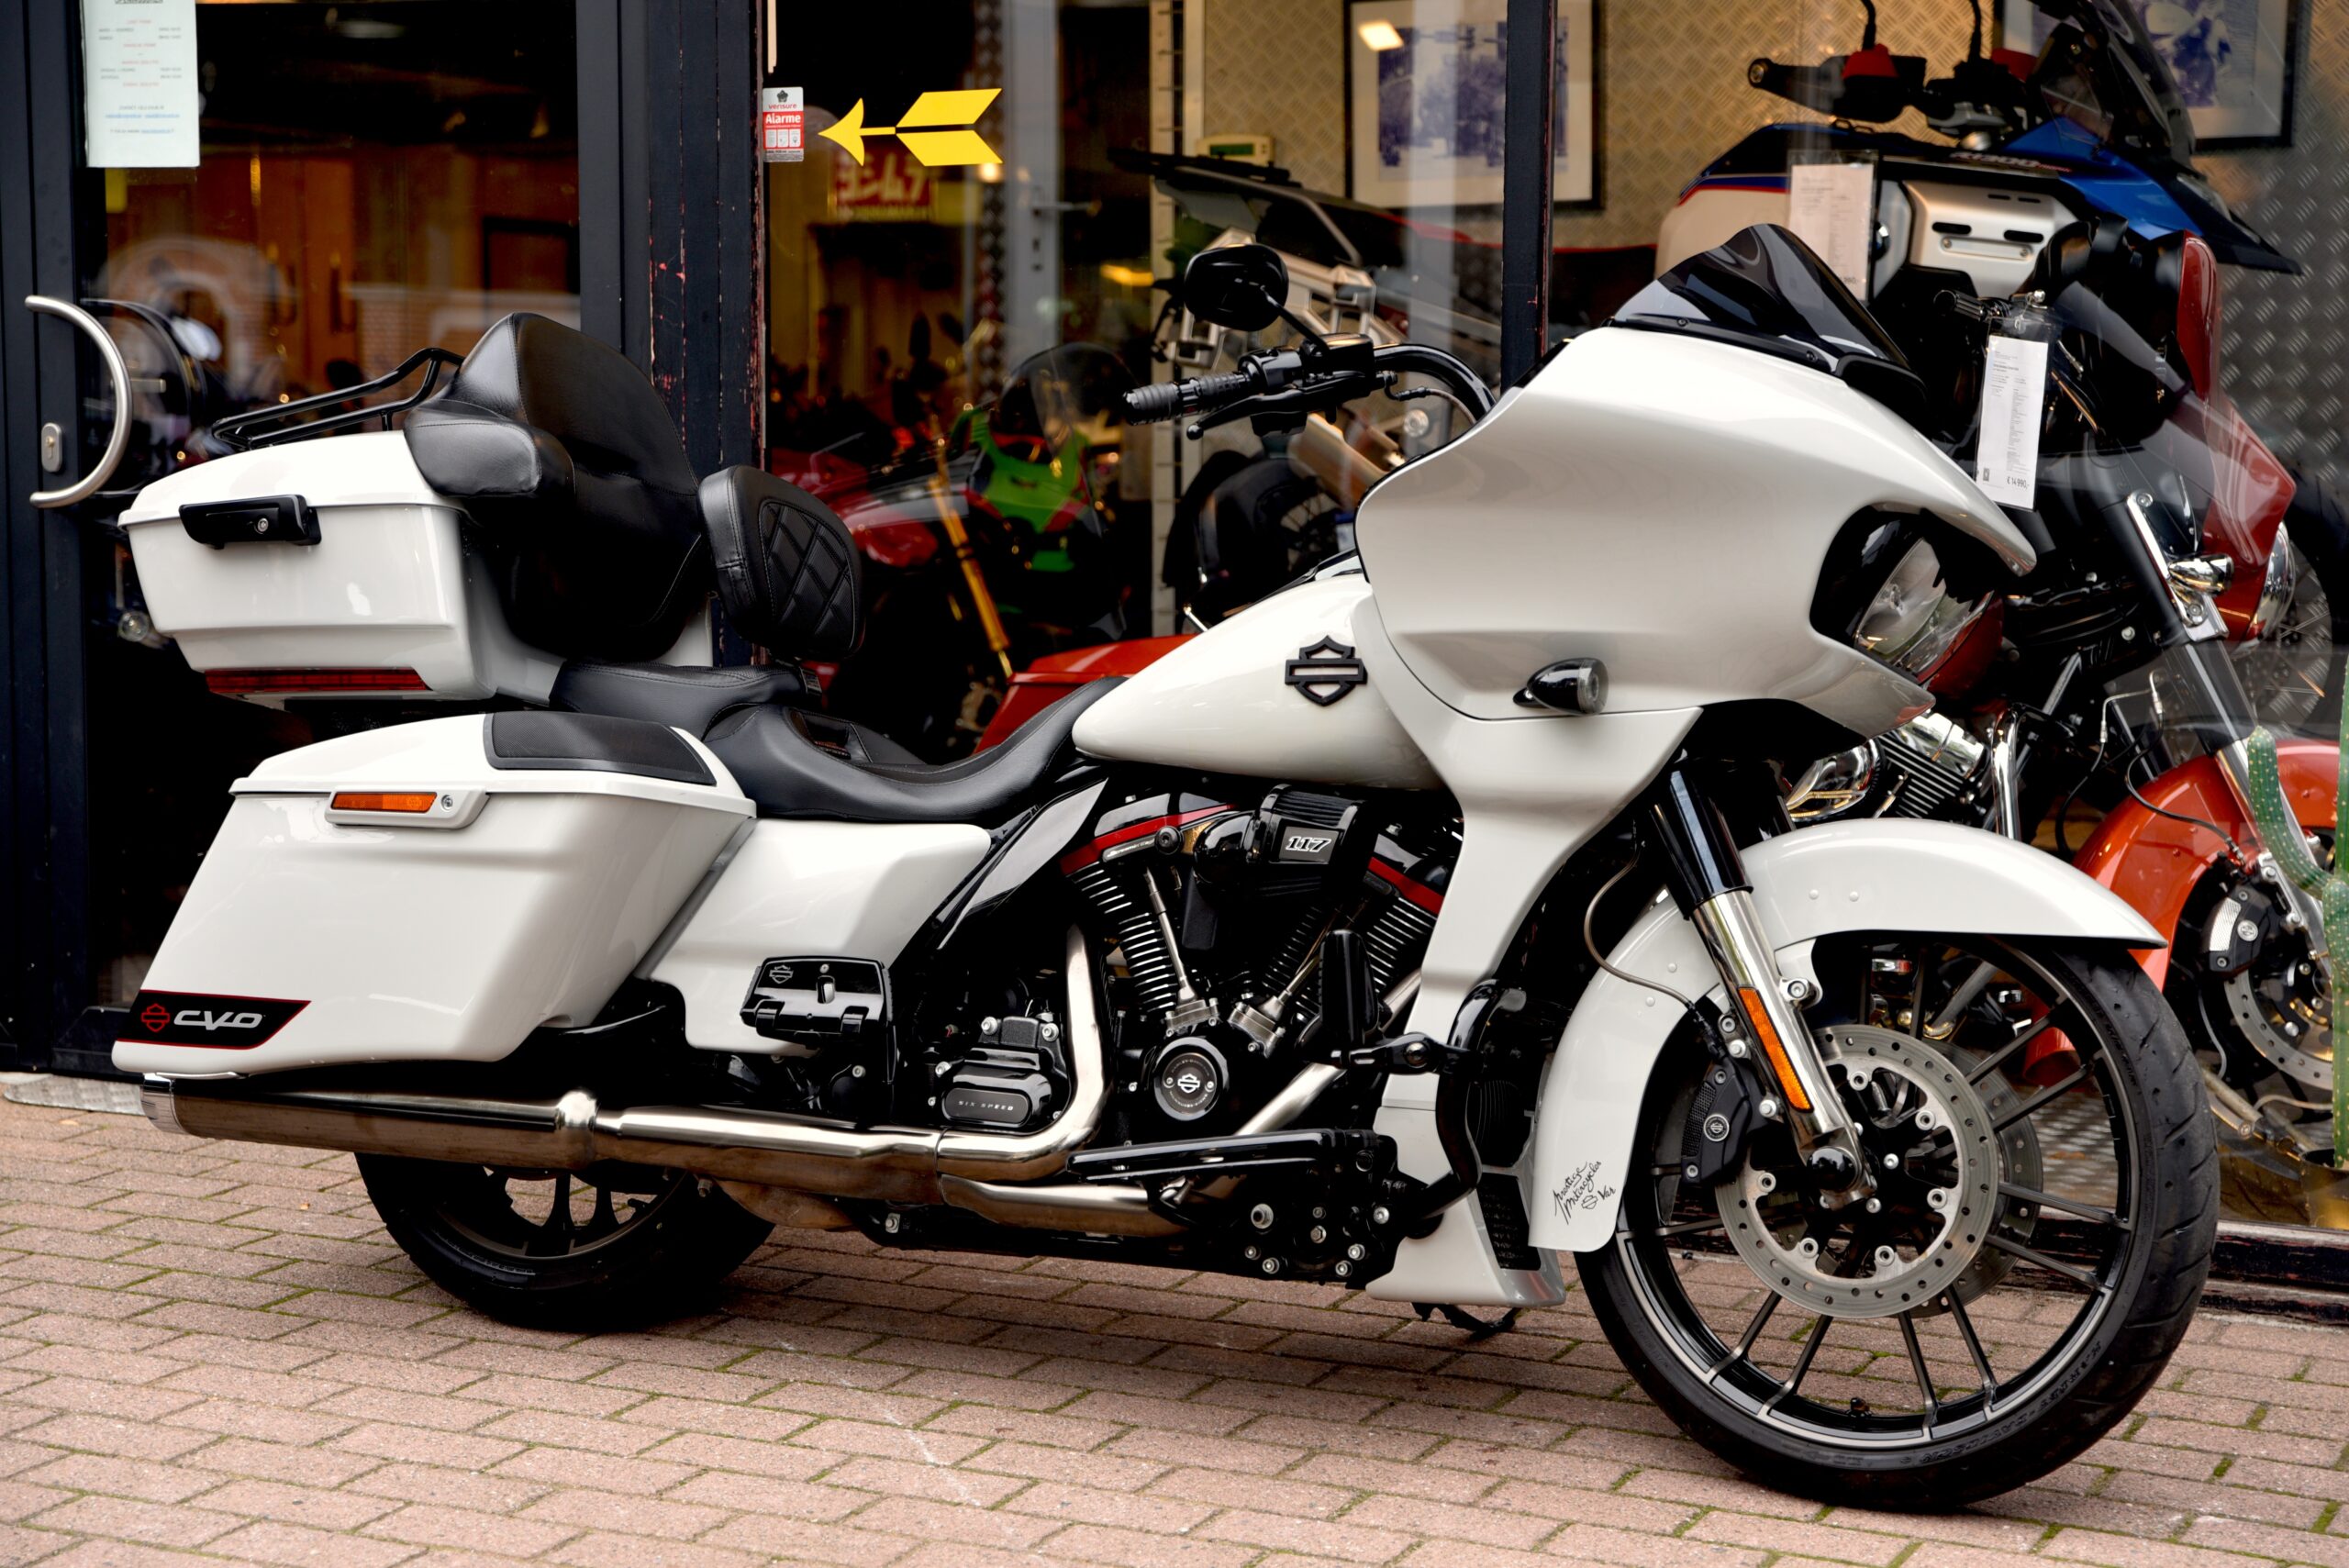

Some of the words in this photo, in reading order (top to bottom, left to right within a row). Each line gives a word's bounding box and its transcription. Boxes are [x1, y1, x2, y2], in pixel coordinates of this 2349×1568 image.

[765, 113, 801, 124] Alarme
[1286, 836, 1331, 852] 117
[173, 1009, 263, 1030] CVO
[981, 1103, 1014, 1111] SPEED
